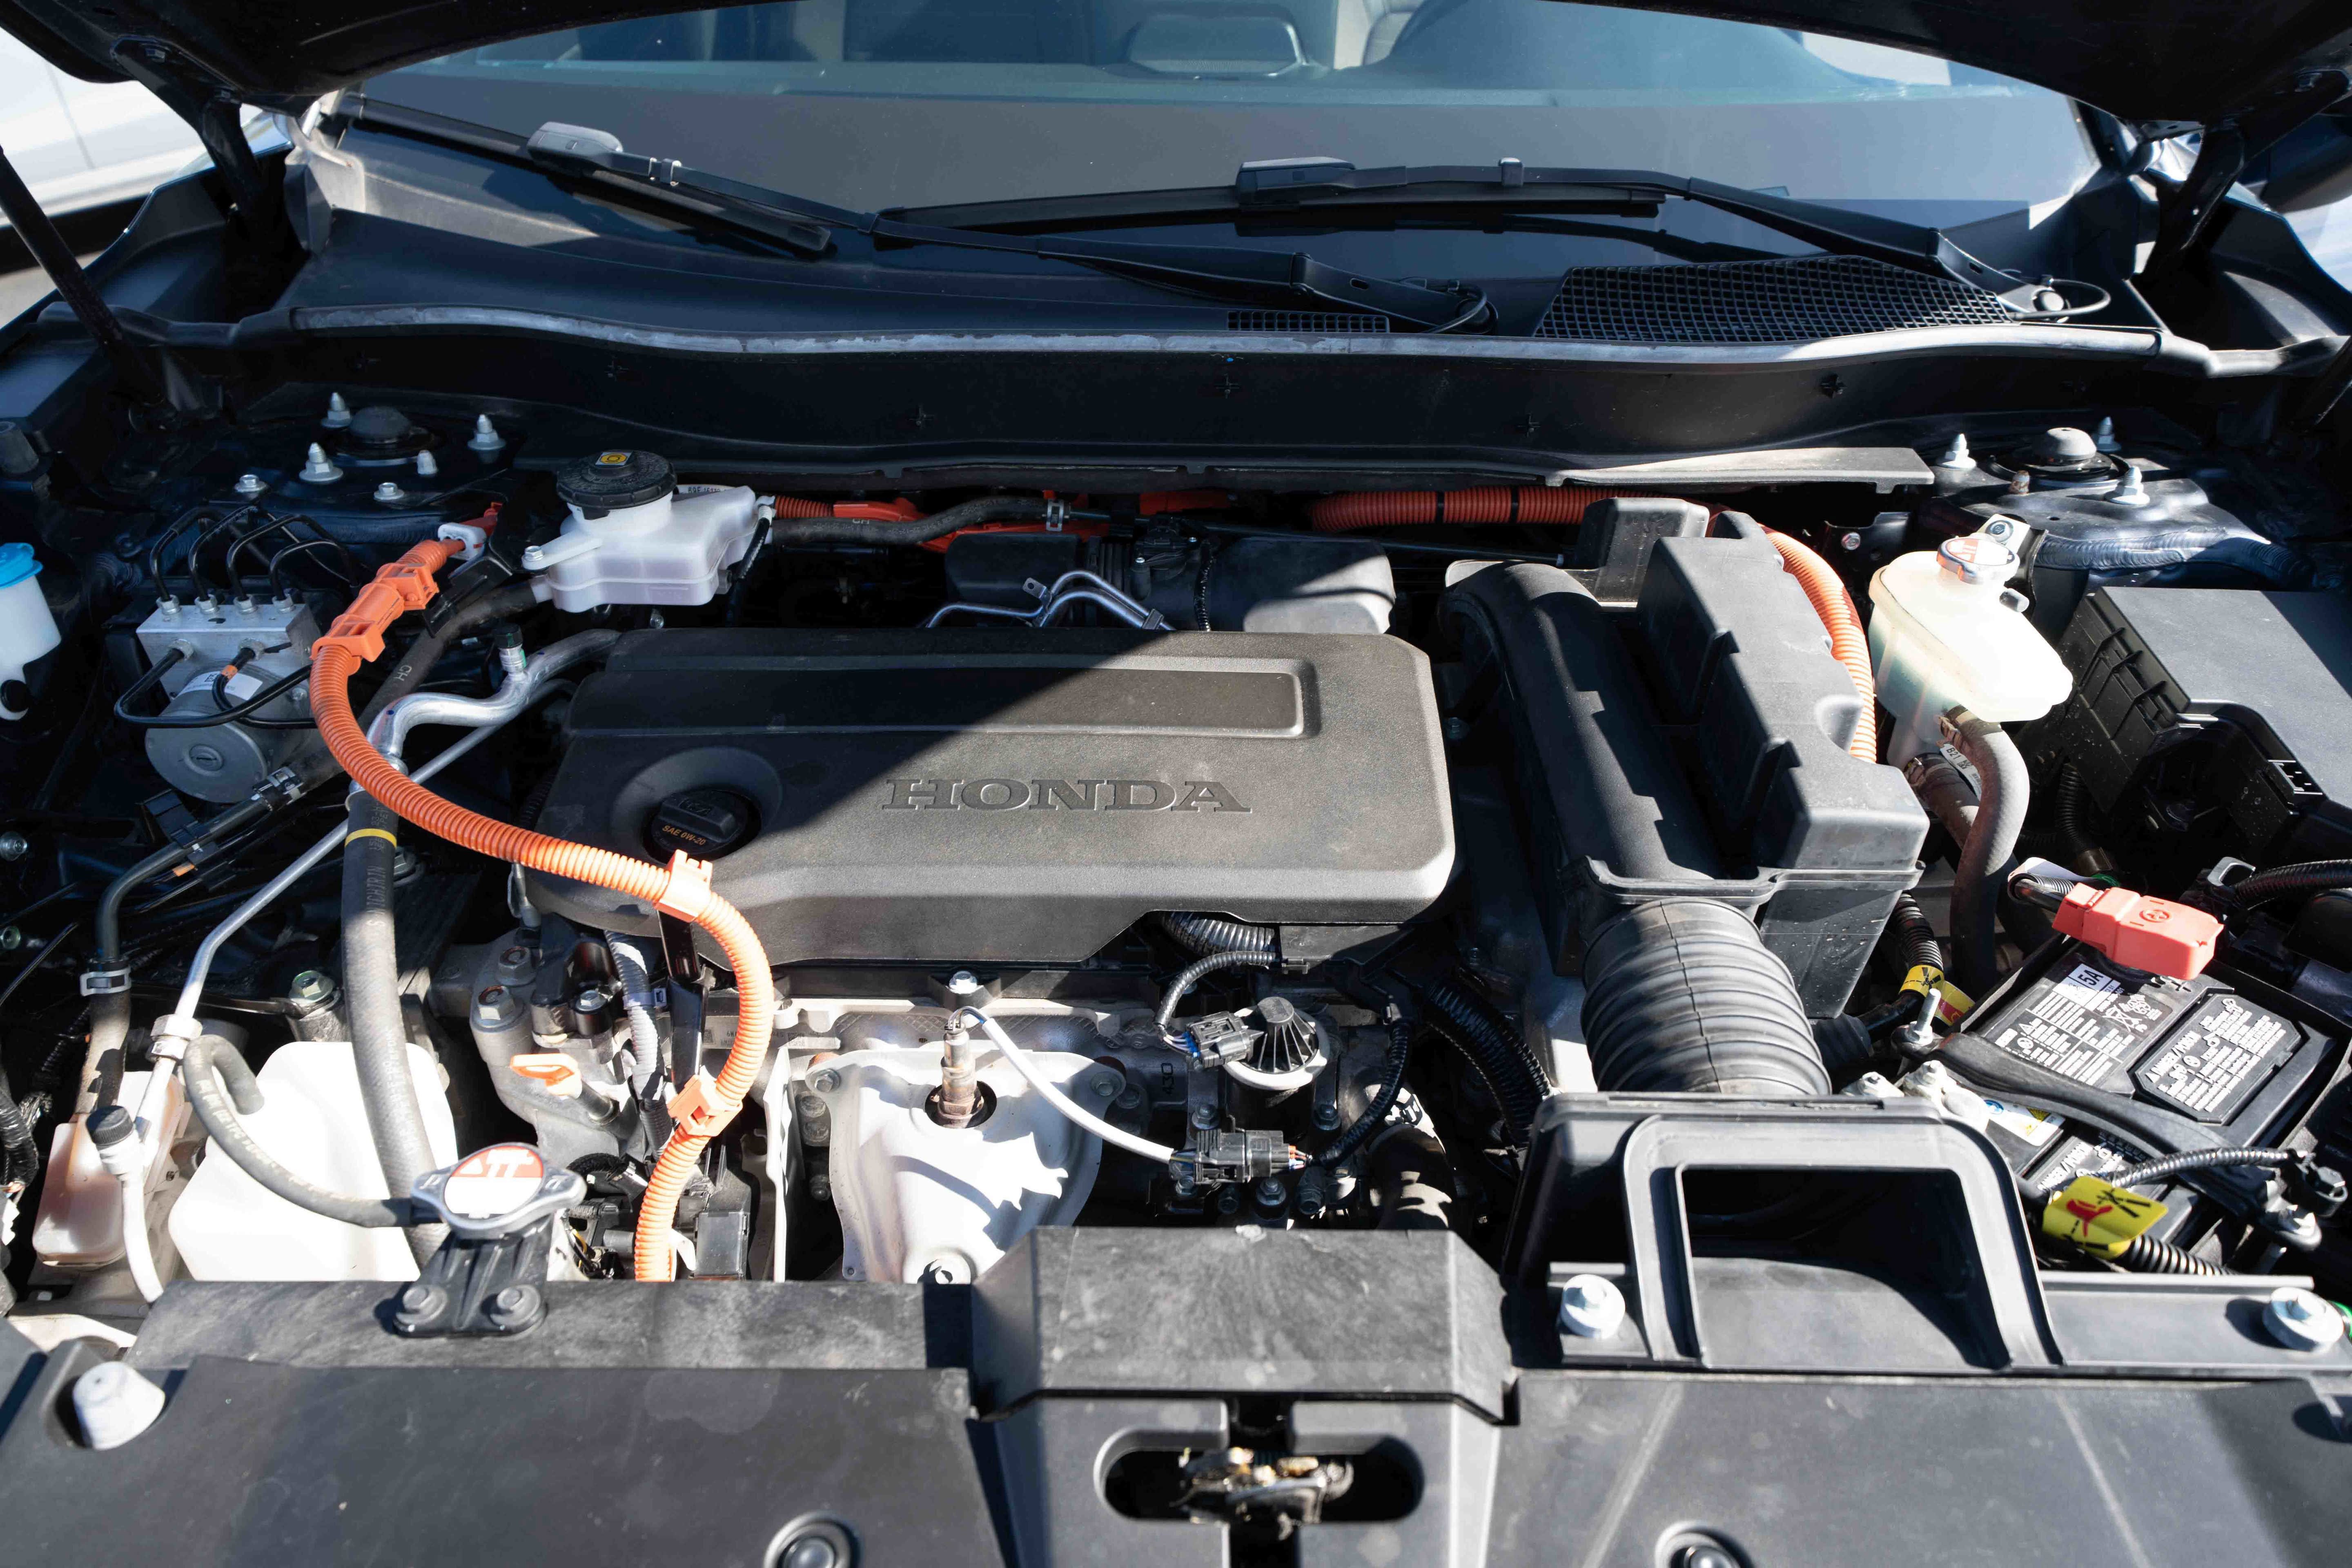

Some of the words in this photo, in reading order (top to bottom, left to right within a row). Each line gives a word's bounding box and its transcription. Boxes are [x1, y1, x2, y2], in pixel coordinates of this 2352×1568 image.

[1946, 746, 1961, 761] B21
[881, 778, 1252, 813] HONDA
[662, 825, 682, 836] SAE
[680, 832, 706, 845] 0W-20
[2078, 969, 2104, 986] 5A
